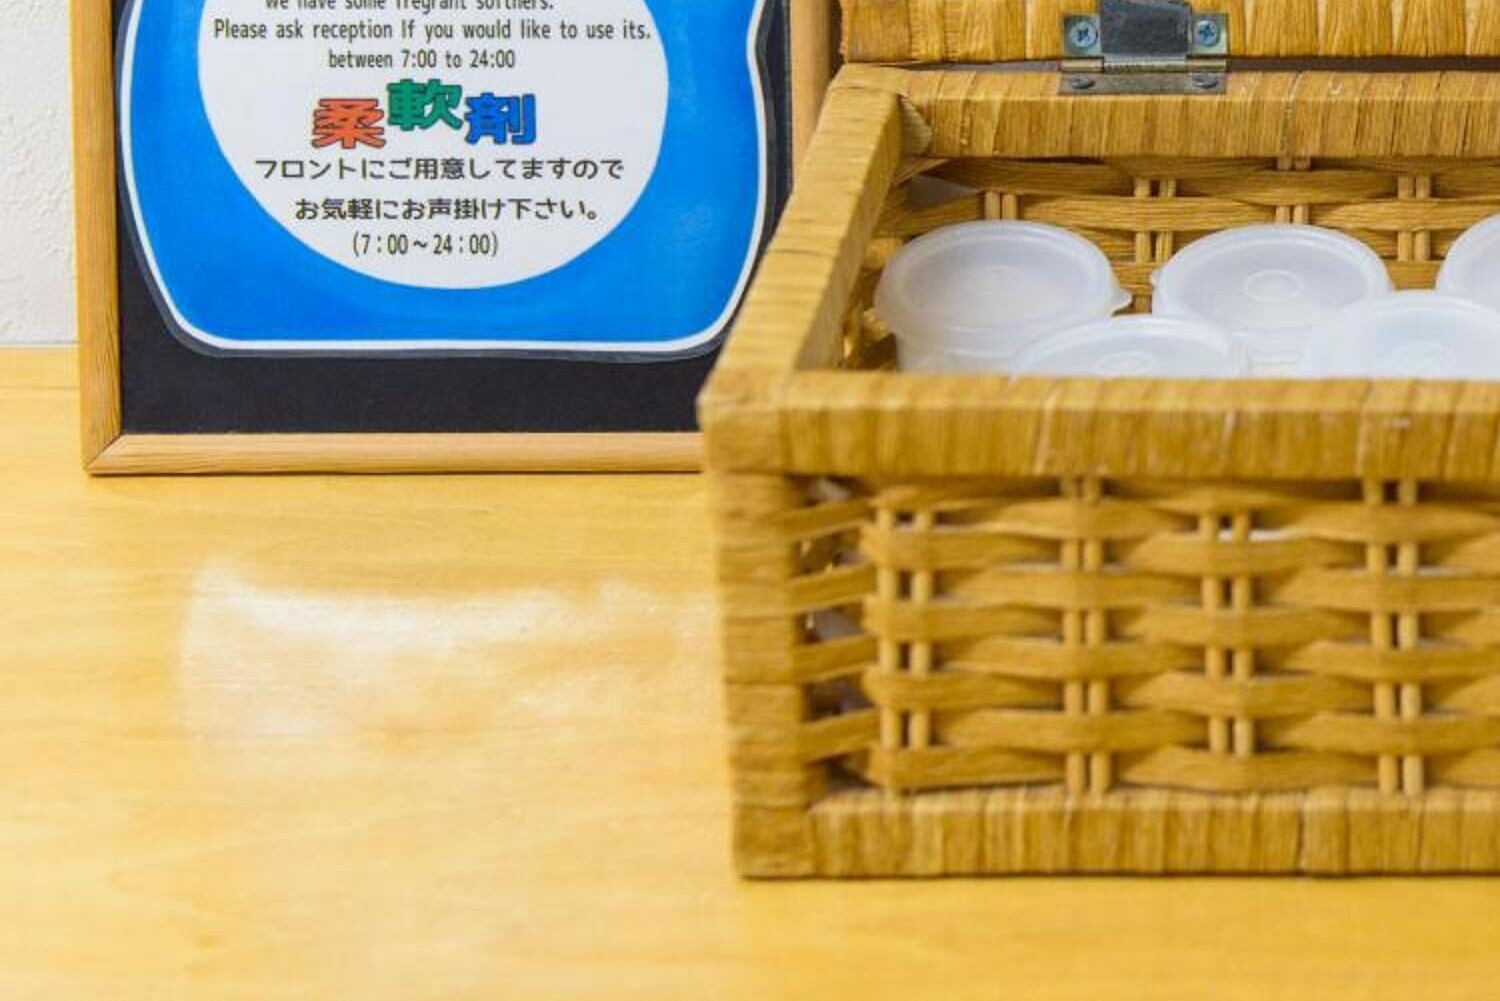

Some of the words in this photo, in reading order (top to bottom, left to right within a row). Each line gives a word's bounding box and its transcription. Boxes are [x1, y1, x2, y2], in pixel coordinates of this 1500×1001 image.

[214, 19, 267, 40] Please
[276, 19, 304, 40] ask
[313, 19, 393, 45] reception
[401, 19, 415, 40] If
[424, 24, 454, 45] you
[463, 19, 511, 40] would
[520, 19, 551, 40] like
[560, 21, 578, 40] to
[586, 24, 615, 40] use
[623, 19, 652, 40] its.
[328, 49, 394, 69] between
[401, 49, 437, 69] 7:00
[445, 52, 462, 69] to
[469, 49, 516, 69] 24:00
[312, 78, 538, 150] 柔軟剤
[255, 157, 625, 180] フロントにご用意してますので
[295, 198, 599, 221] お気軽にお声掛け下さい。
